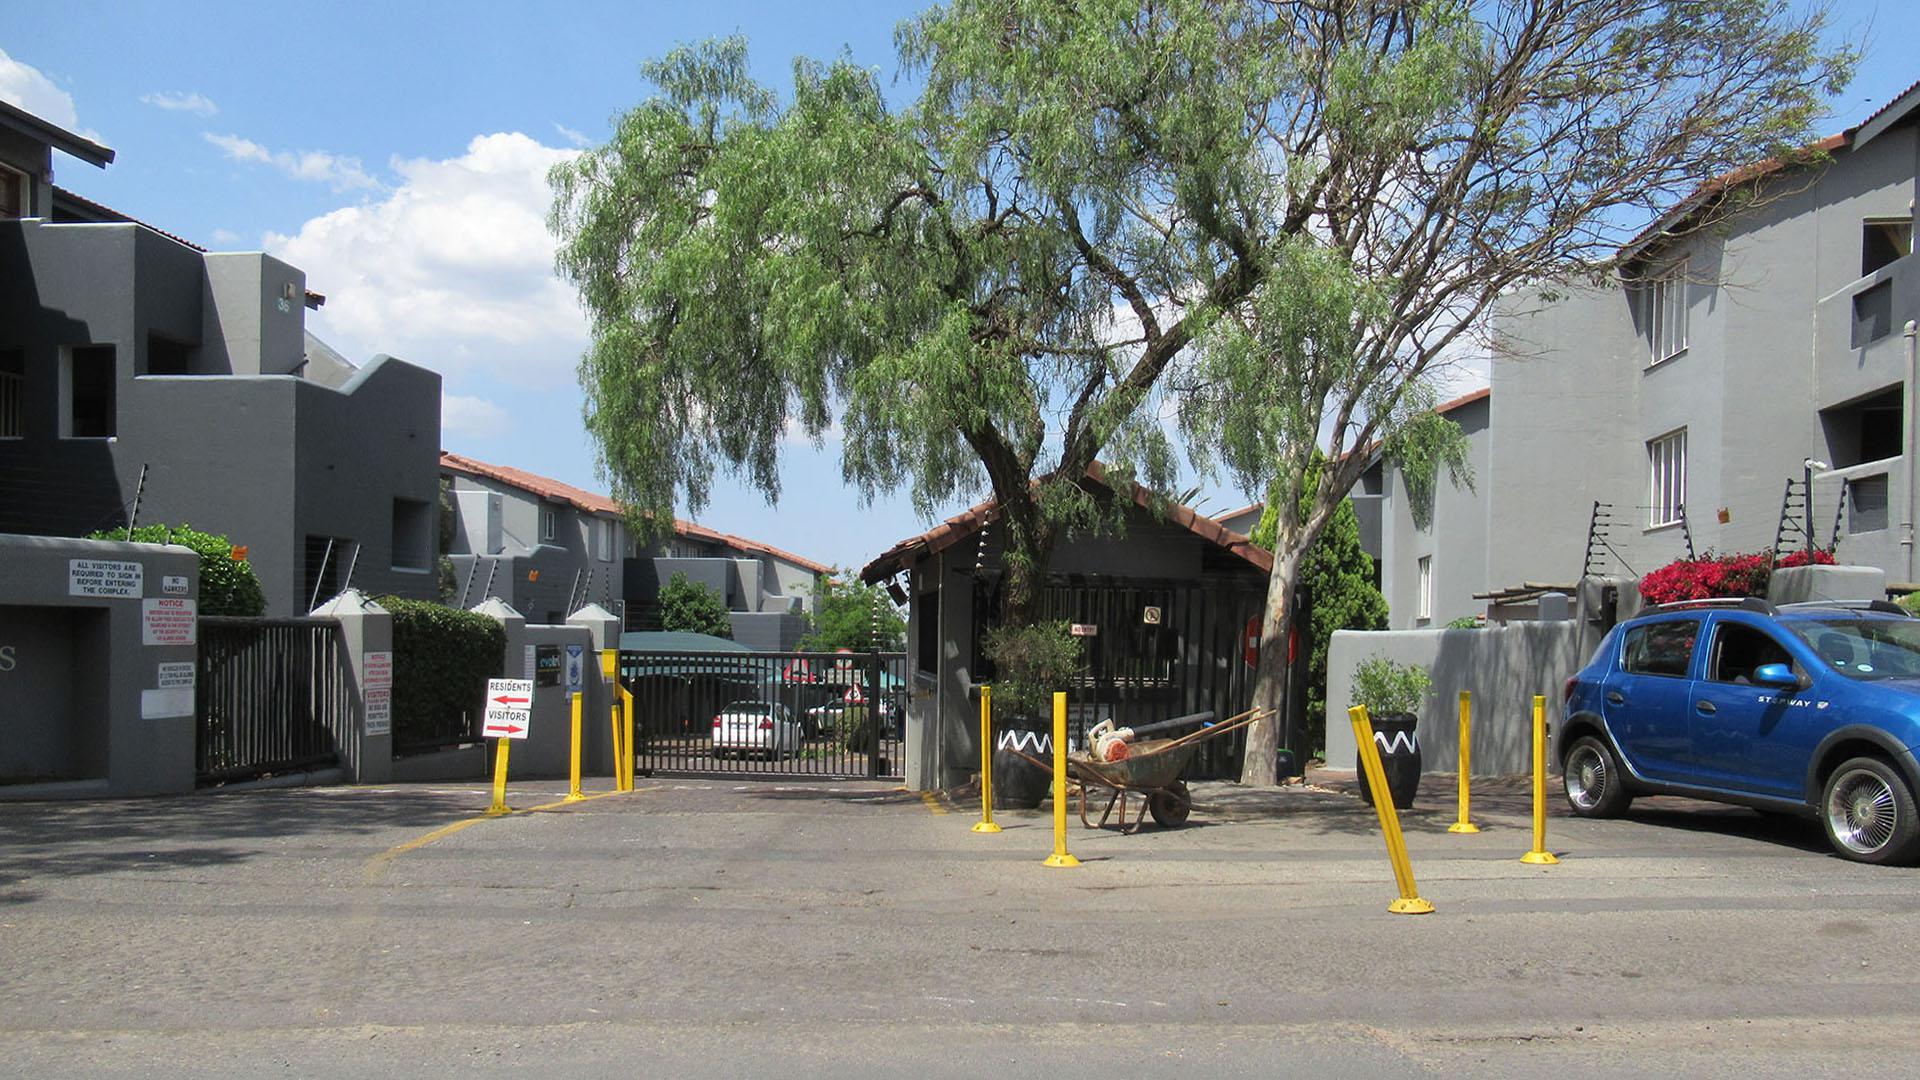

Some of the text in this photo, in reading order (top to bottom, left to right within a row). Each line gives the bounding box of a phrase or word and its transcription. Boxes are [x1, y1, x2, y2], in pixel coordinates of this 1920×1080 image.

[92, 563, 121, 571] VISITORS
[72, 570, 104, 578] REQUIRED
[77, 578, 103, 586] BEFORE
[158, 599, 184, 607] NOTICE
[489, 682, 532, 692] RESIDENTS
[488, 710, 527, 721] VISITORS
